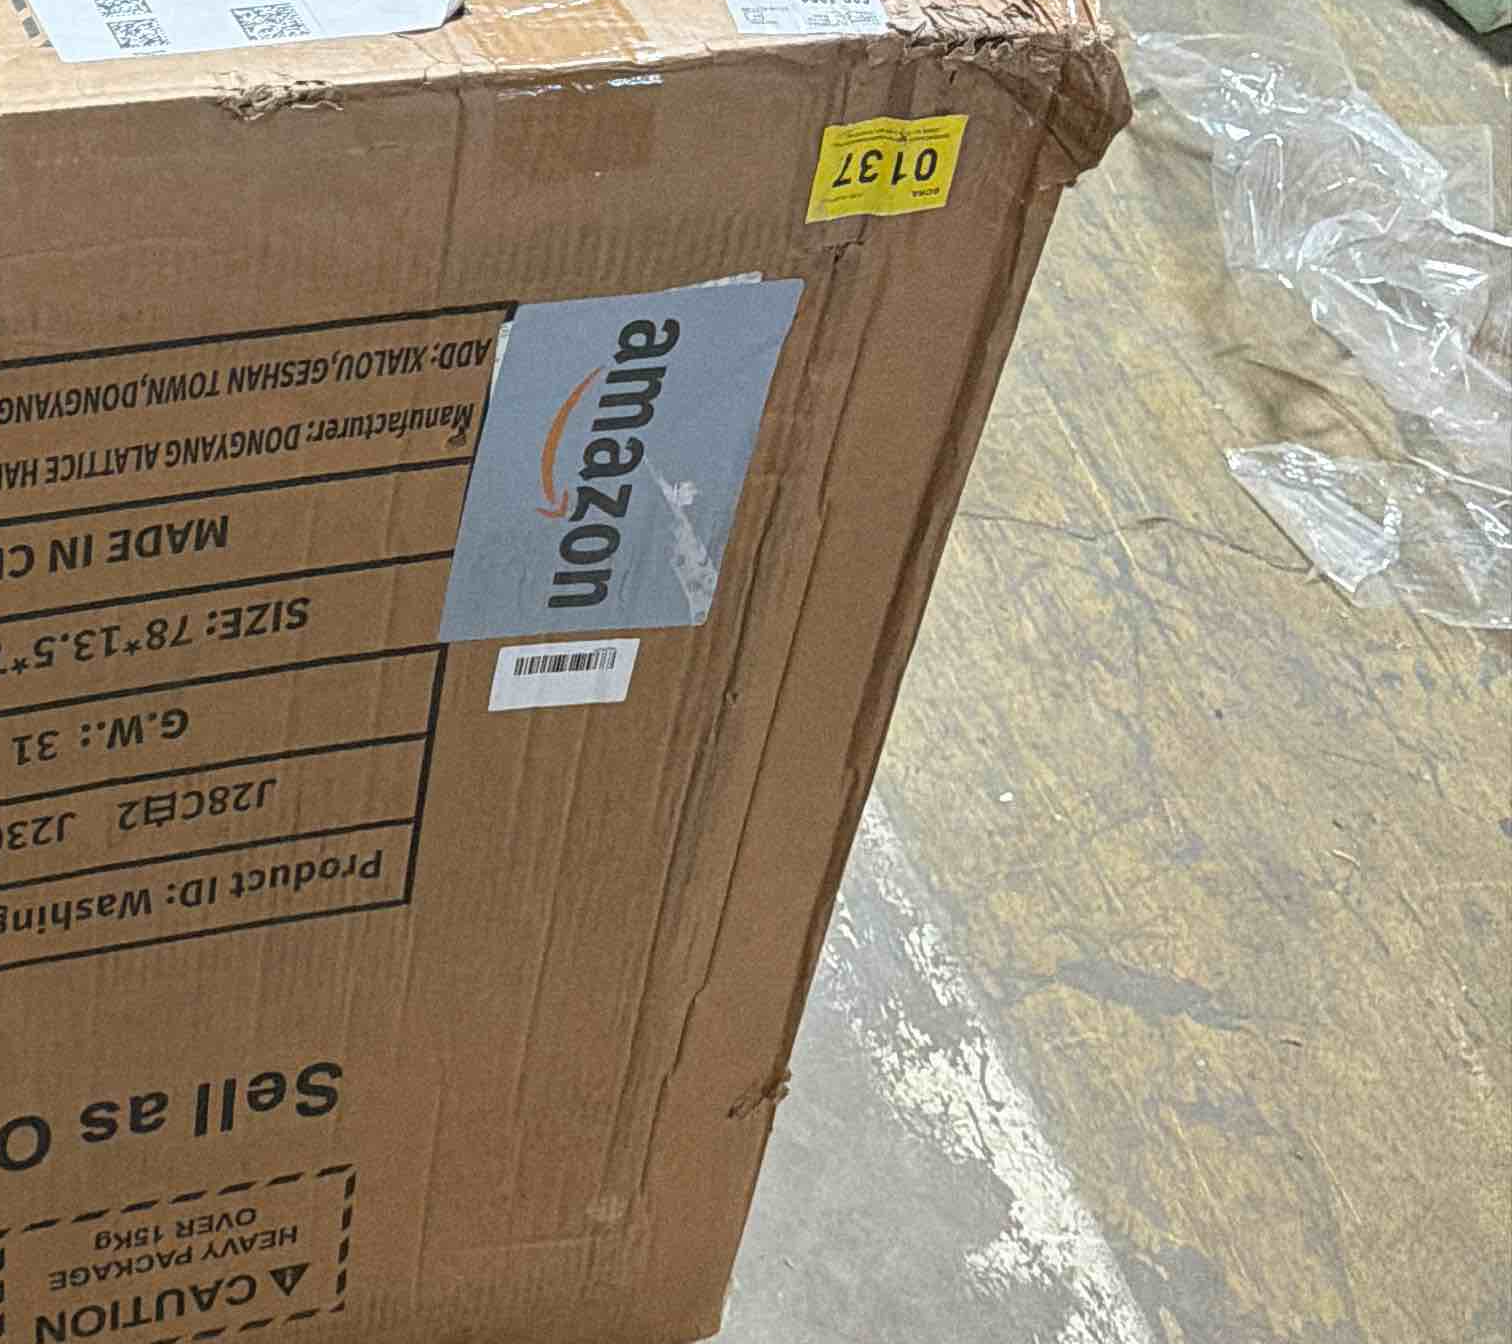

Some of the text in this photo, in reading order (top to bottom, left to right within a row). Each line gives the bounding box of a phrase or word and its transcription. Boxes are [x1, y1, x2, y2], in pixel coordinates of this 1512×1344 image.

[832, 146, 940, 187] 0137
[228, 347, 425, 393] XIALOU,GESHAN
[429, 338, 492, 372] ADD:
[165, 422, 301, 468] DONGYANG
[306, 403, 474, 443] Manufacturer:
[45, 440, 160, 483] ALATTICE
[548, 317, 681, 609] amazon
[50, 534, 92, 571] IN
[109, 516, 229, 565] MADE
[206, 597, 310, 639] SIZE:
[10, 730, 60, 765] 31
[78, 707, 189, 752] G.W.:
[165, 874, 217, 908] ID:
[230, 849, 382, 899] Product
[80, 1090, 170, 1143] as
[194, 1060, 344, 1137] Sell
[94, 1207, 258, 1252] OVER 15Kg
[48, 1224, 299, 1291] HEAVY PACKAGE
